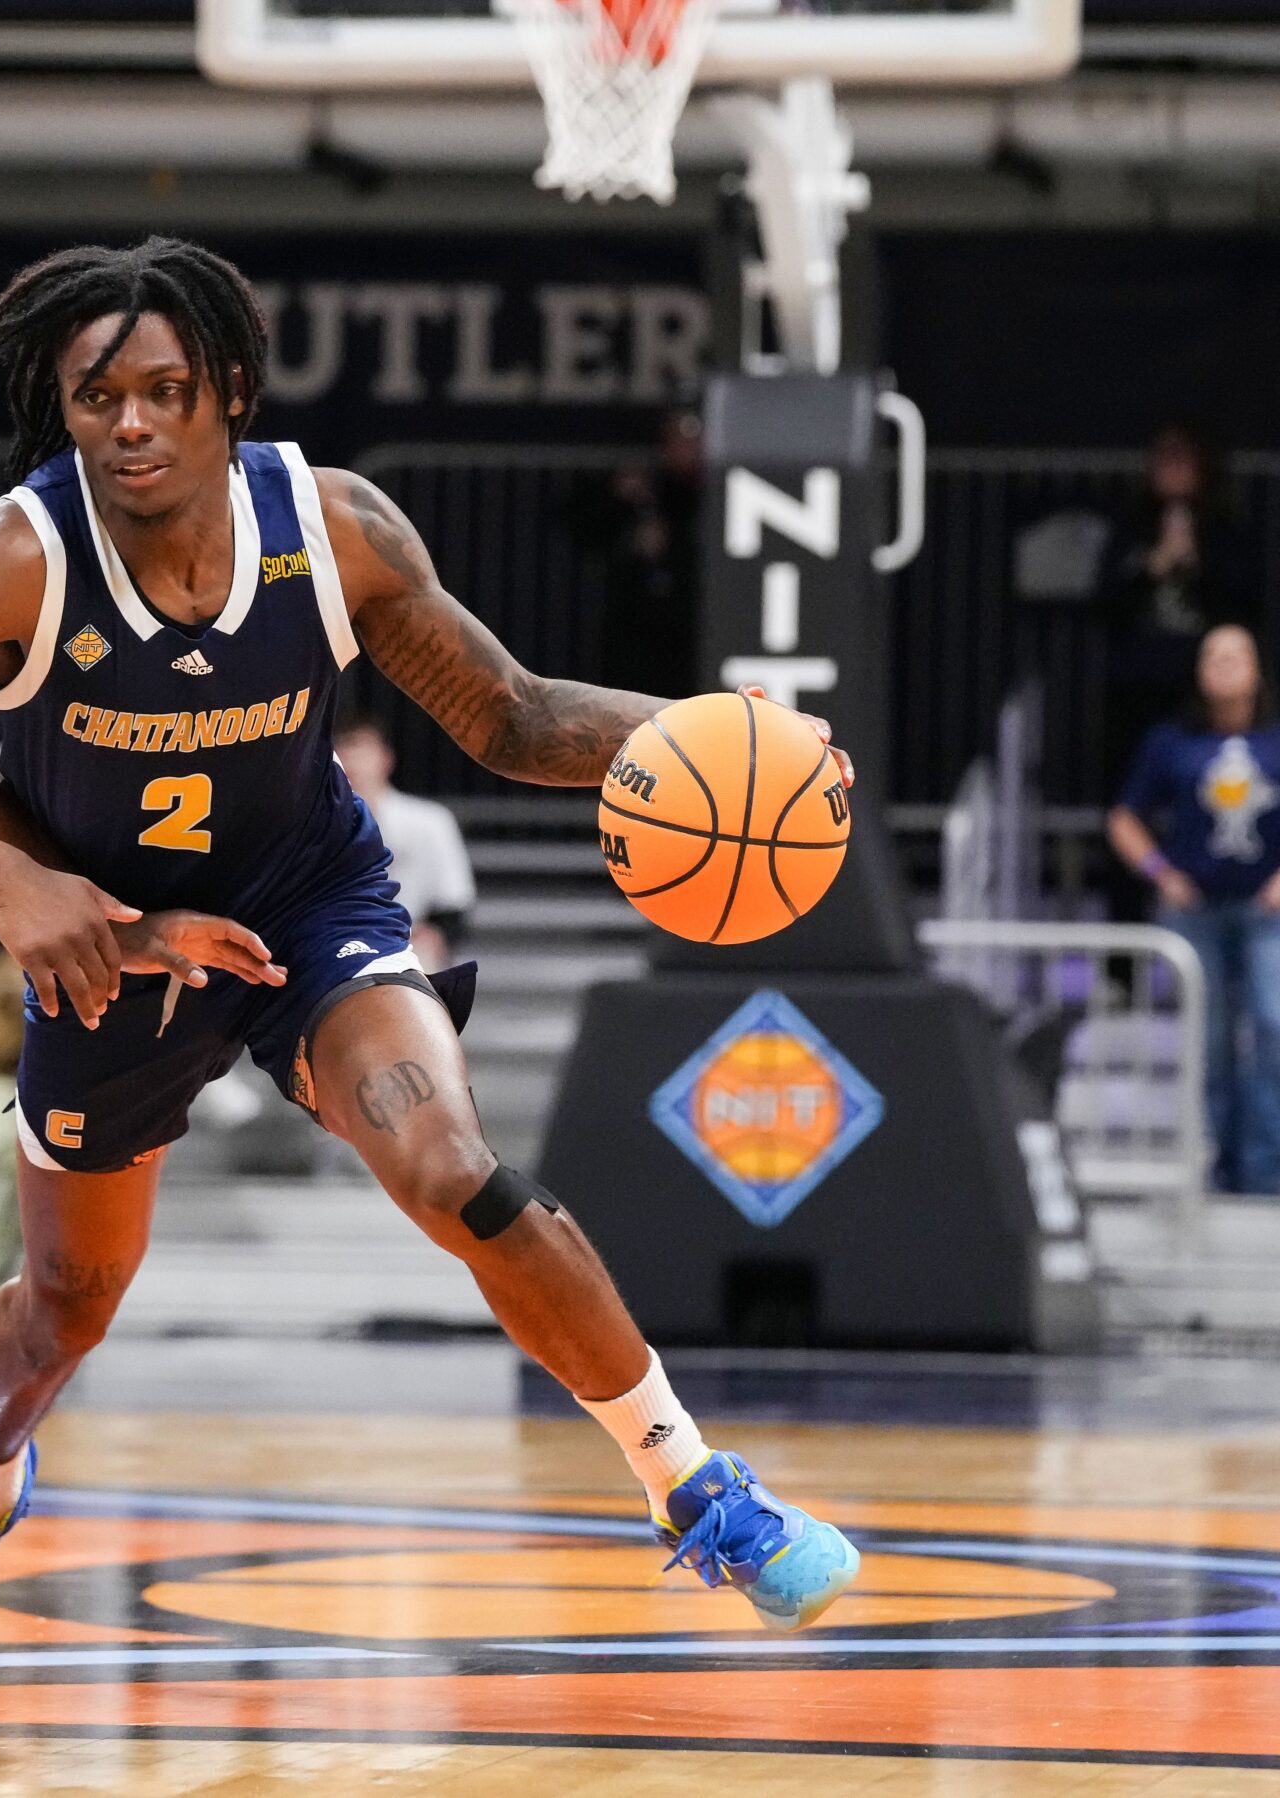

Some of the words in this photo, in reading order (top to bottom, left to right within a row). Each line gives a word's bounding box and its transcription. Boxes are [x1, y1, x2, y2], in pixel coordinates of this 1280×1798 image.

[256, 281, 713, 402] UTLER
[73, 643, 102, 653] NIT
[171, 660, 214, 676] adidas
[62, 687, 311, 753] CHATTANOOGA
[138, 773, 213, 854] 2
[45, 1109, 85, 1149] C
[702, 1083, 830, 1130] NIT
